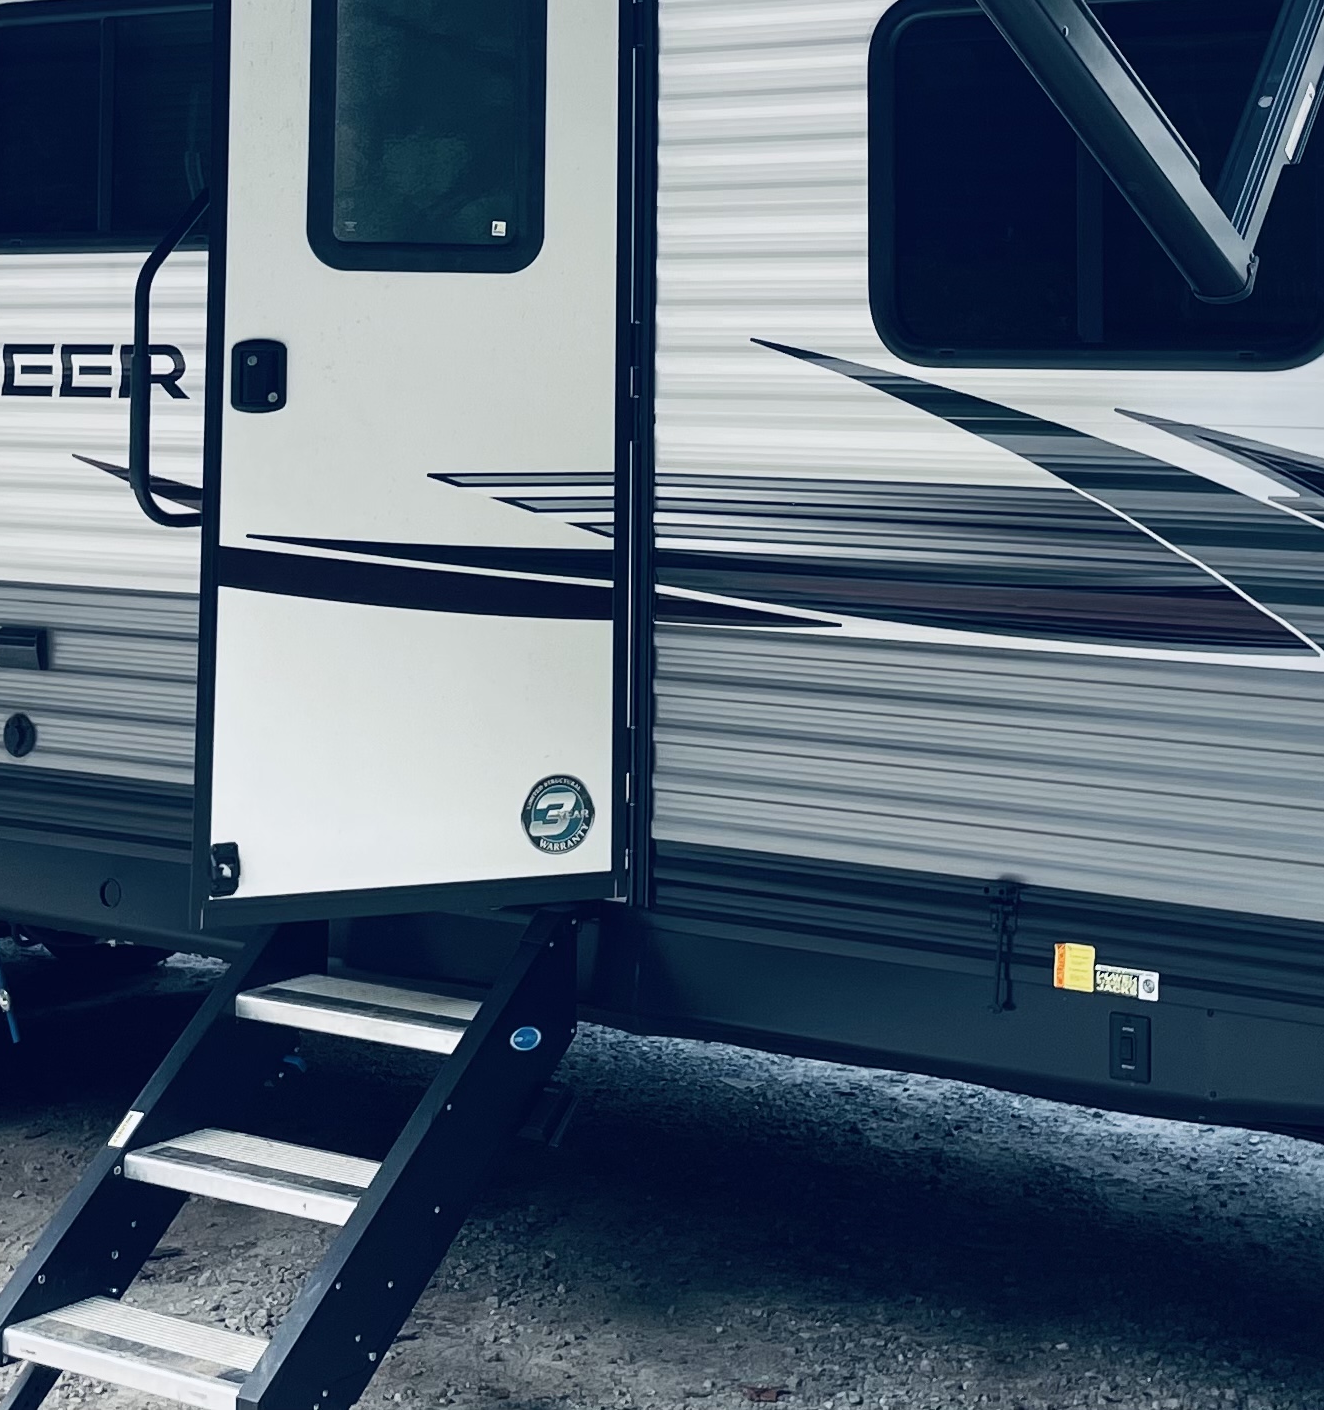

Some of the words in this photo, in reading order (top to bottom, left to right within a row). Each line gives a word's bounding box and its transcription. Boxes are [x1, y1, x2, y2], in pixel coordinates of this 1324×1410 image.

[528, 791, 577, 837] 3
[556, 808, 590, 820] YEAR
[539, 822, 589, 851] WARRANTY
